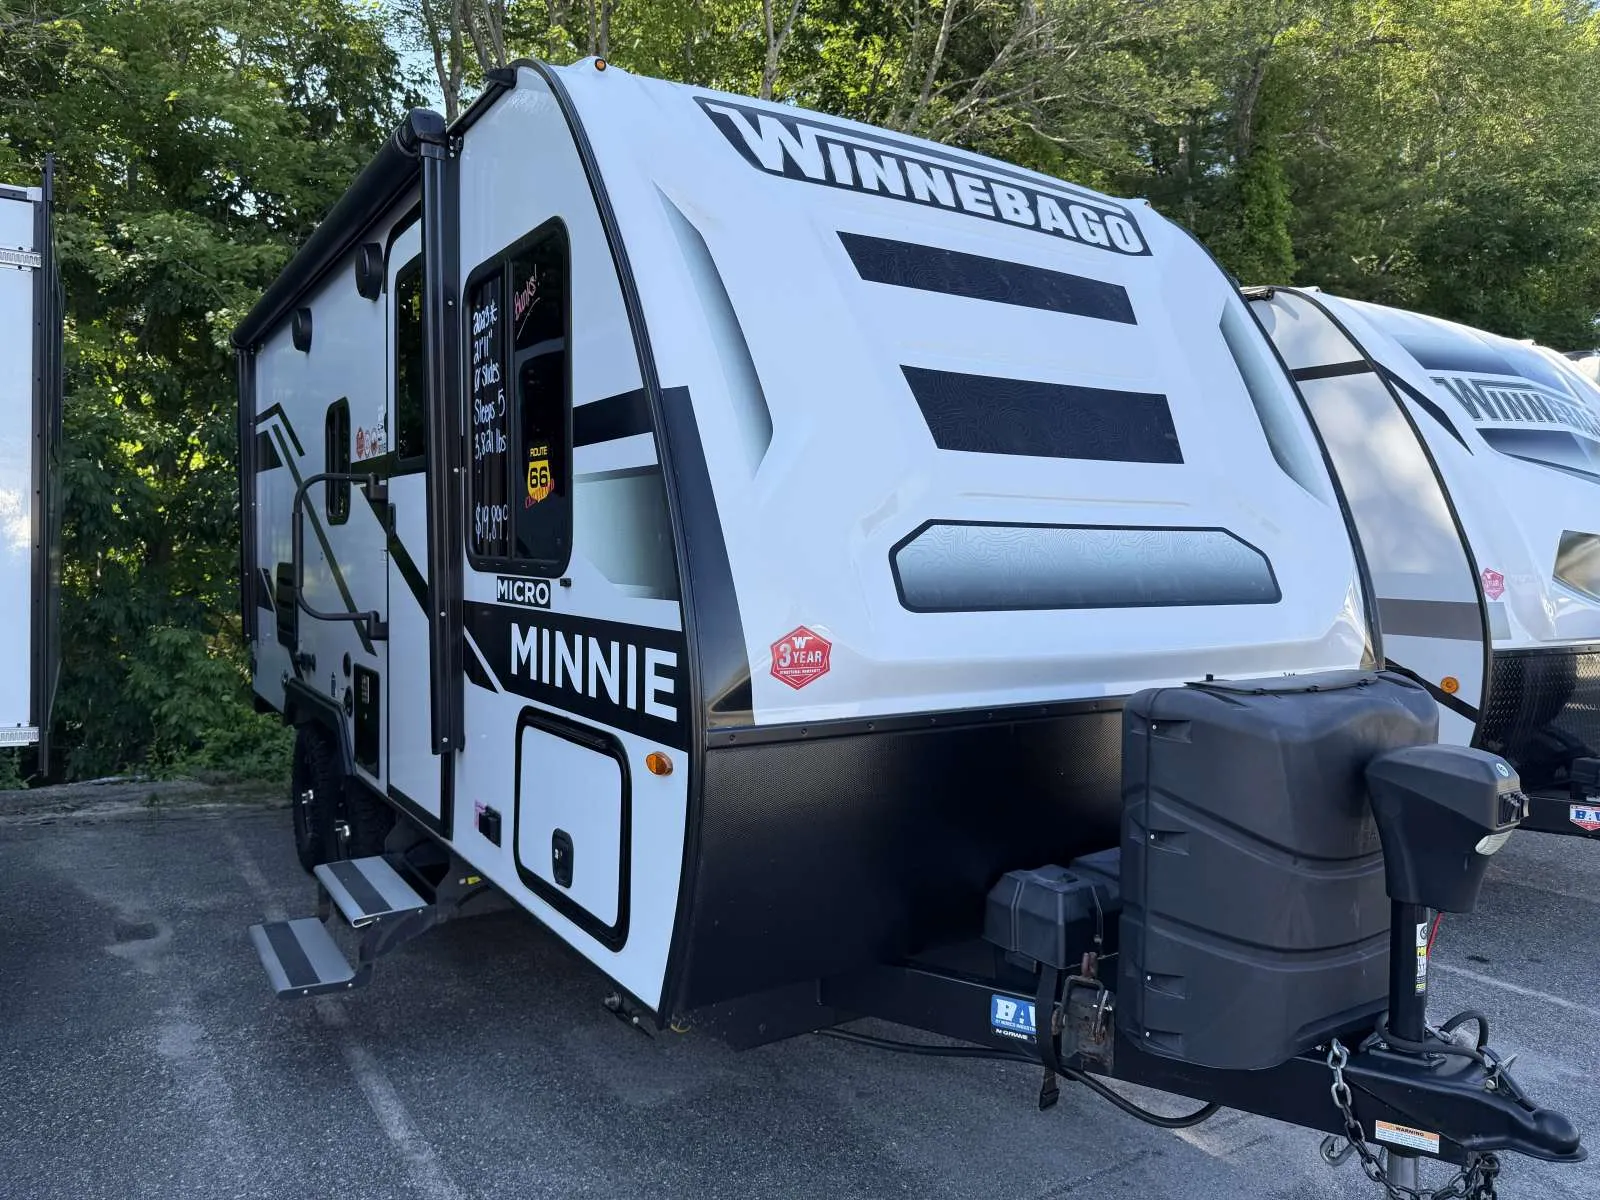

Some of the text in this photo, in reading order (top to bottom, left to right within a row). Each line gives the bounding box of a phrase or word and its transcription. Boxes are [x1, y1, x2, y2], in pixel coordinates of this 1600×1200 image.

[704, 102, 1142, 254] WINNEBAGO
[497, 388, 506, 417] 5
[529, 446, 548, 457] ROUTE
[529, 466, 548, 489] 66
[497, 580, 550, 605] MICRO
[779, 643, 822, 668] 3 YEAR
[511, 622, 678, 723] MINNIE
[1395, 1126, 1425, 1137] WARNING
